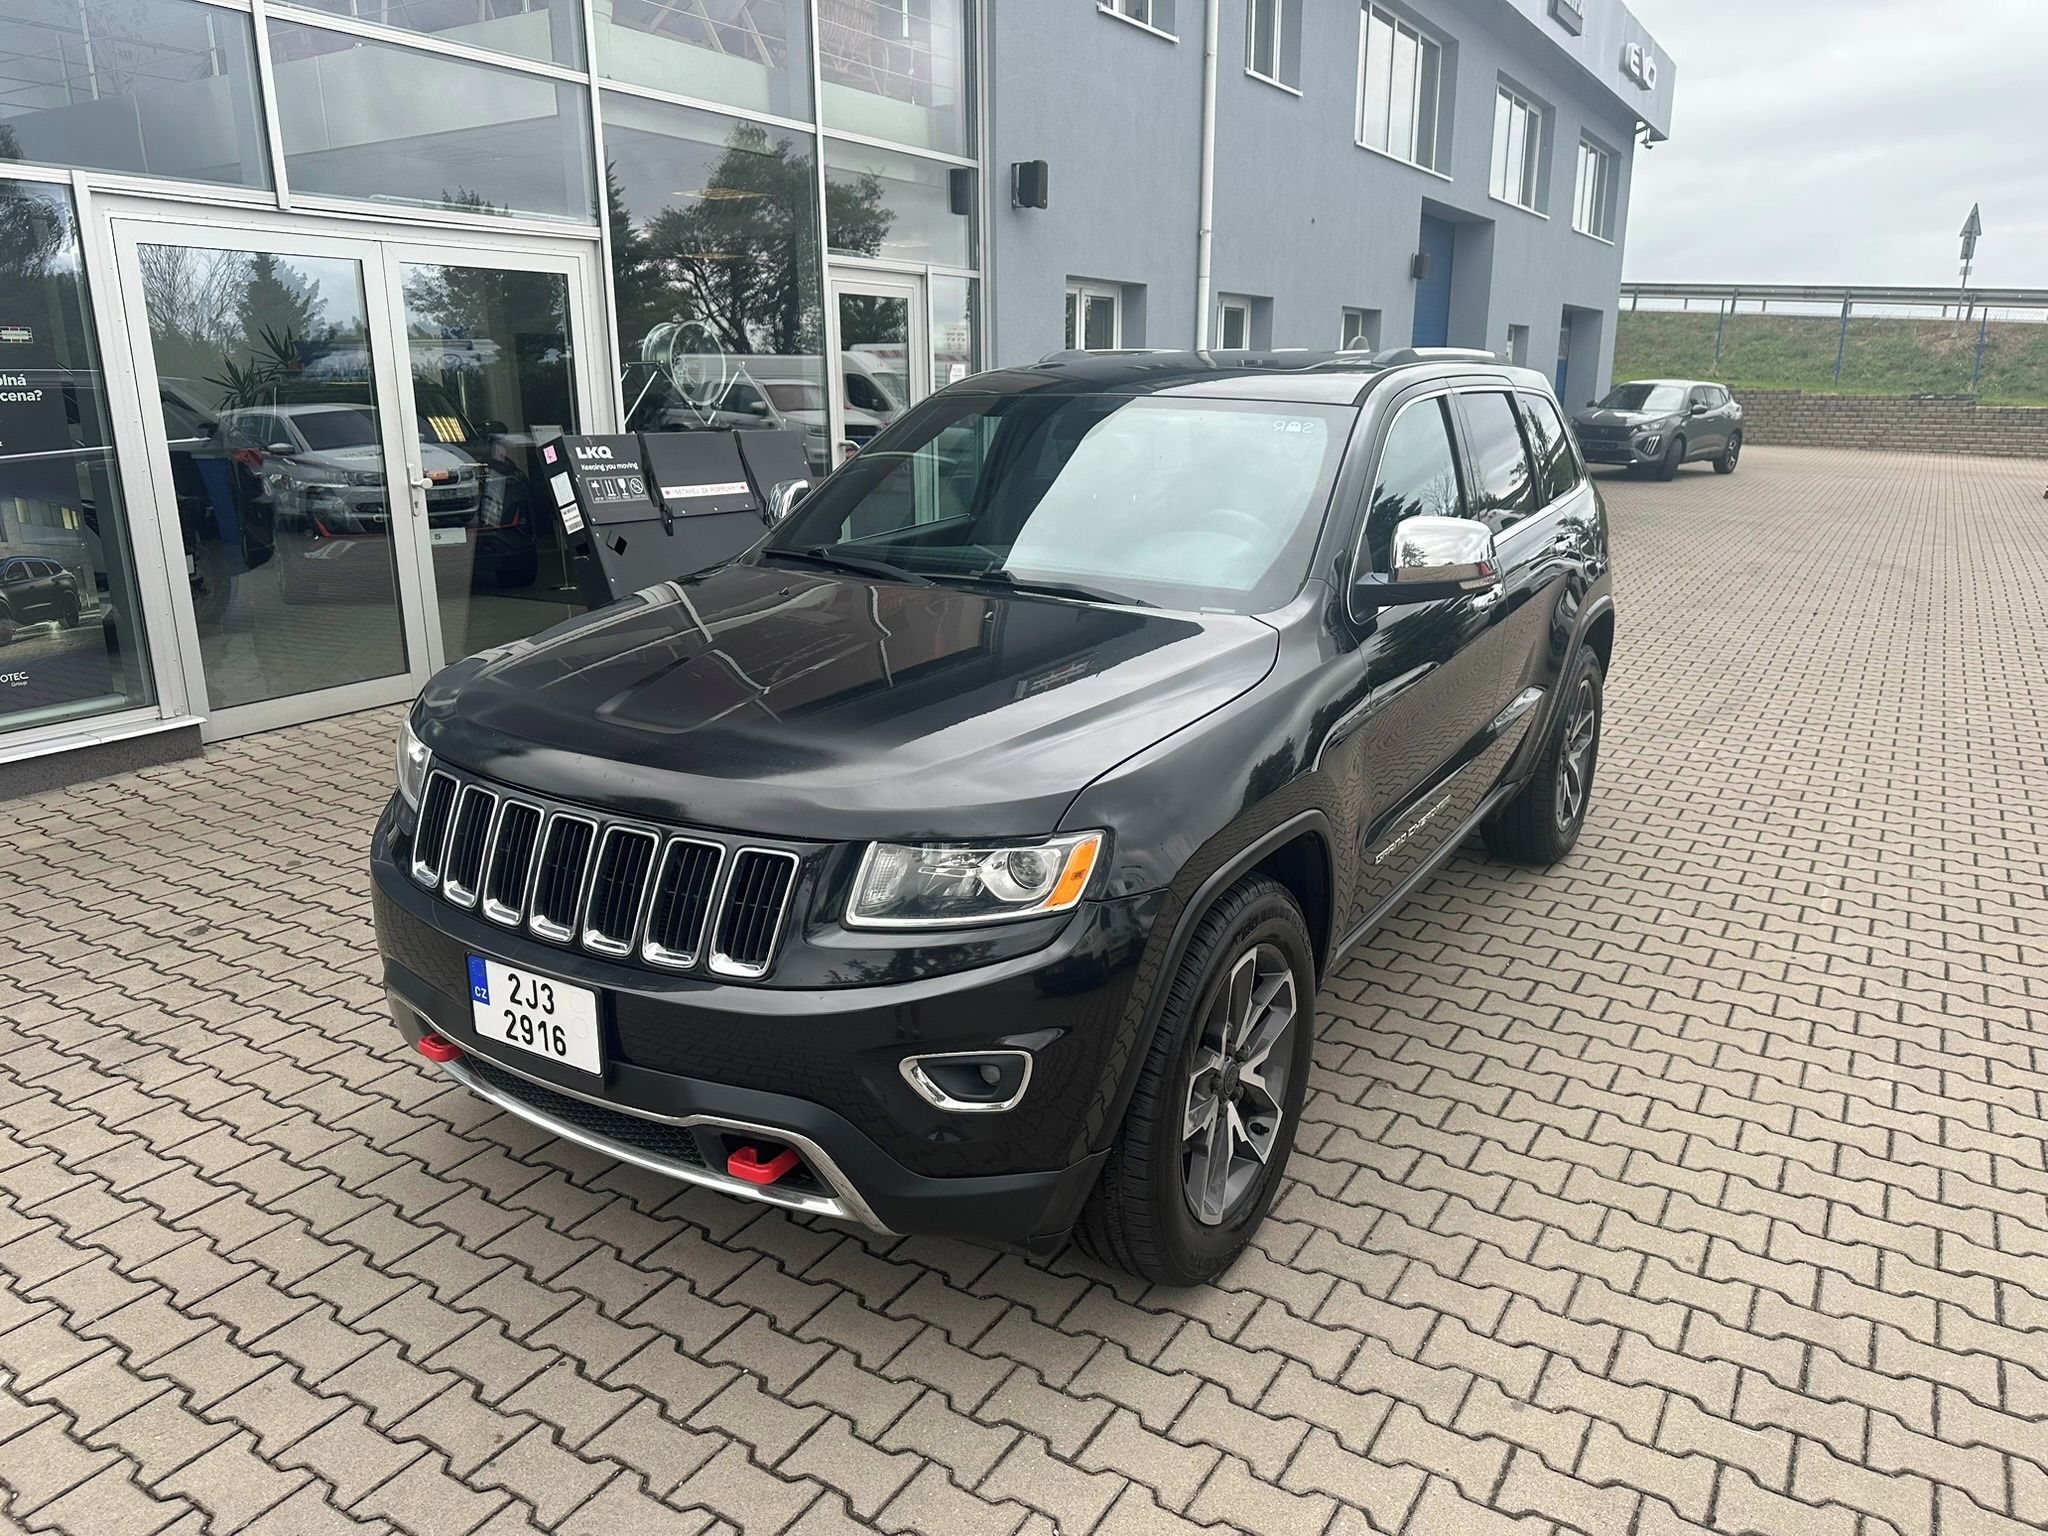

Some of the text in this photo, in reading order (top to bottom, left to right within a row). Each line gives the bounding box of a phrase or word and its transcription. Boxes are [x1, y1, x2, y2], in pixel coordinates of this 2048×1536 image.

[0, 389, 43, 402] cena?
[575, 445, 614, 459] LKQ
[605, 463, 617, 472] you
[617, 461, 639, 471] moving
[474, 986, 488, 999] CZ
[507, 973, 555, 1015] 2J3
[503, 1009, 567, 1057] 2916
